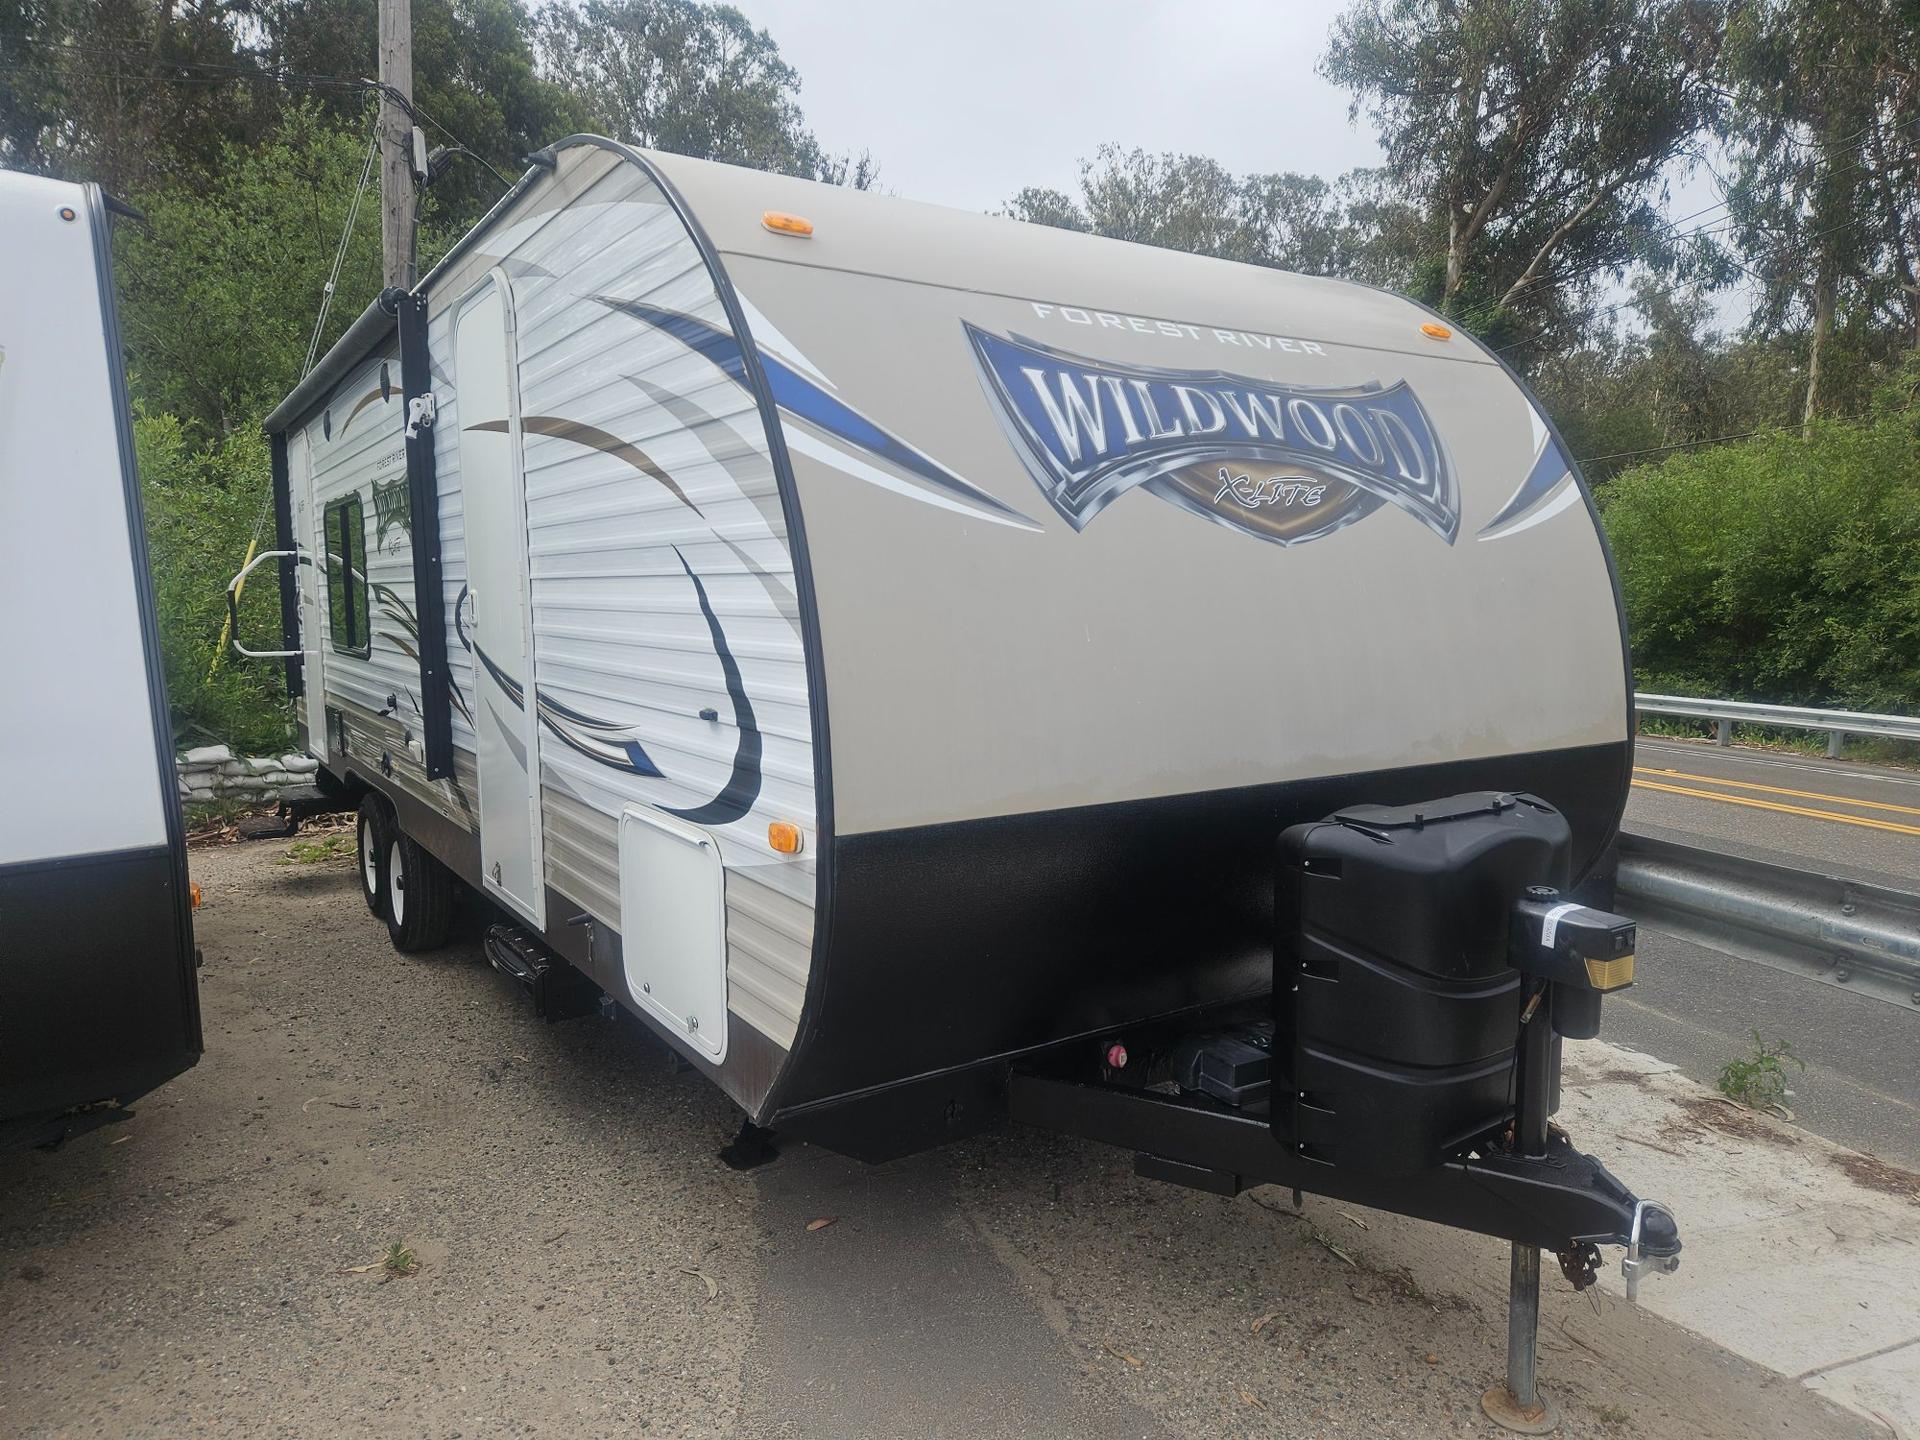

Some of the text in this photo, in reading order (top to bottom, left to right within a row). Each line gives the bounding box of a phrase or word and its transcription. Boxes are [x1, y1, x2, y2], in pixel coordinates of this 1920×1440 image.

[1031, 302, 1327, 356] FOREST RIVER
[1020, 366, 1428, 486] WILDWOOD
[1214, 467, 1326, 508] X-LITE
